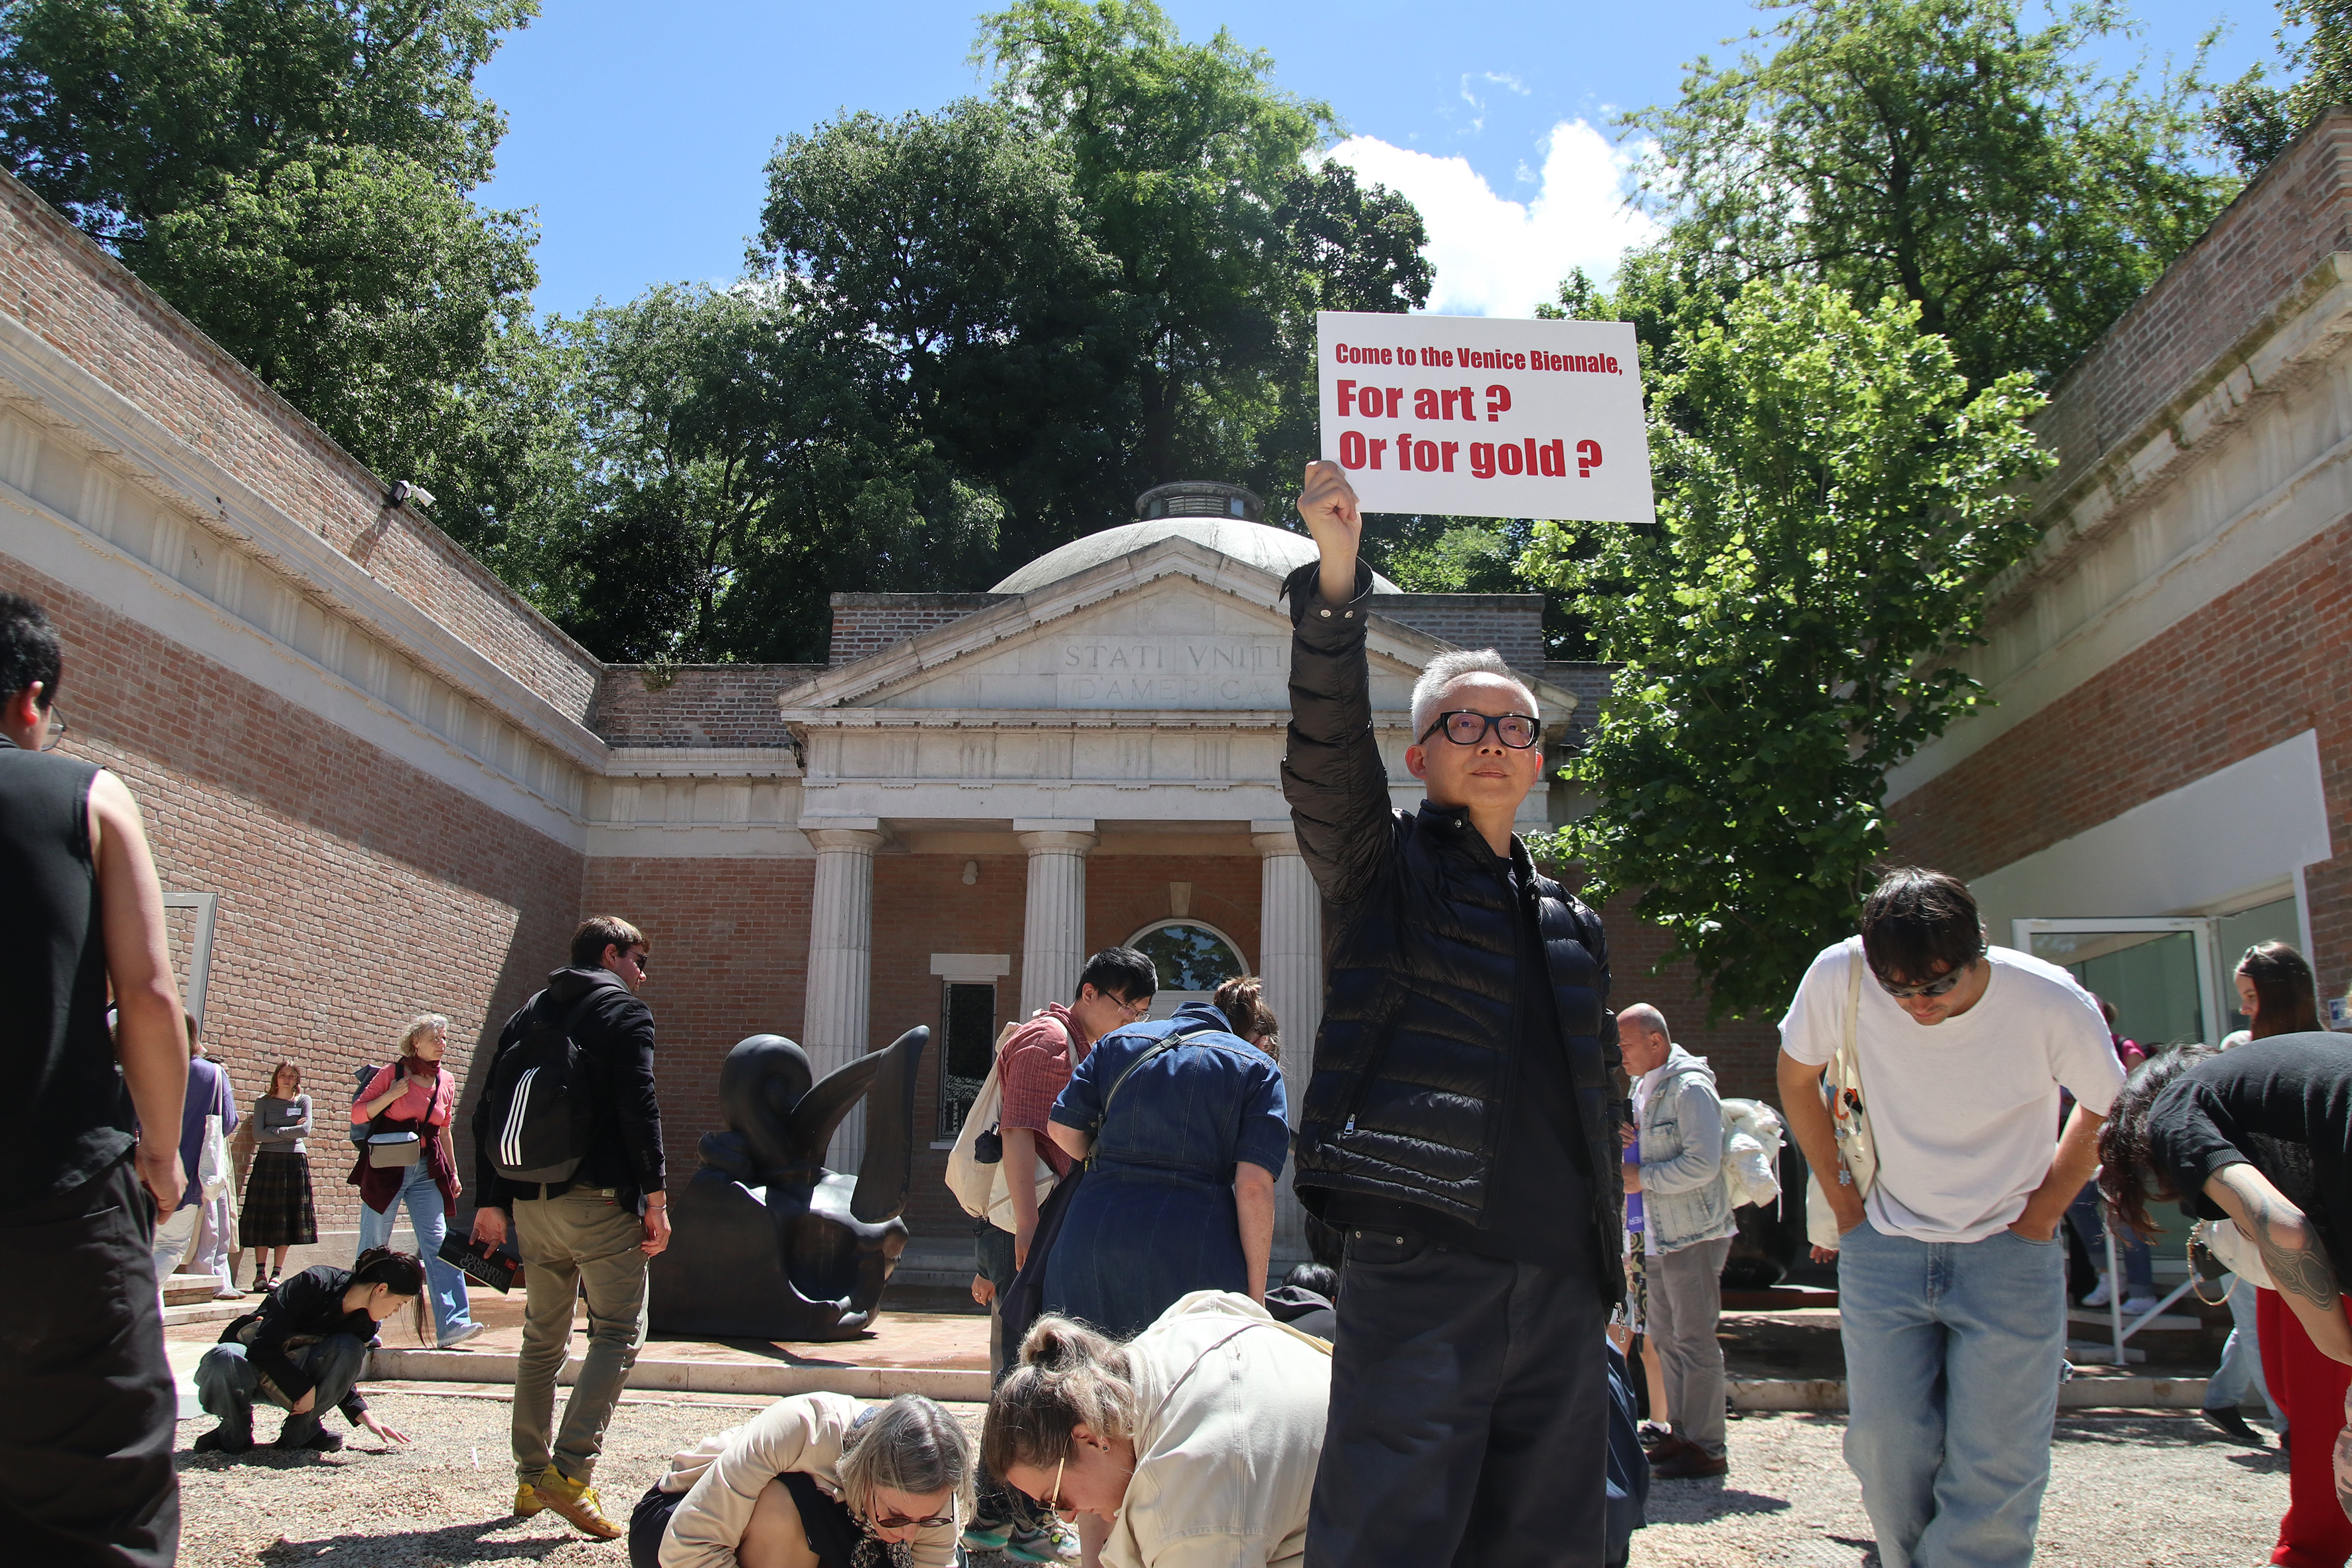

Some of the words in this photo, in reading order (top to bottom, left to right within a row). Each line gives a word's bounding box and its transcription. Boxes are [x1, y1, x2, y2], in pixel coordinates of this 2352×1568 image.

[1336, 343, 1392, 365] Come
[1396, 347, 1417, 366] to
[1421, 347, 1453, 368] the
[1457, 348, 1526, 370] Venice
[1530, 351, 1623, 376] Biennale,
[1337, 380, 1403, 418] For
[1414, 386, 1476, 422] art
[1486, 384, 1512, 422] ?
[1340, 431, 1387, 470] Or
[1396, 433, 1459, 473] for
[1470, 438, 1566, 479] gold
[1577, 439, 1603, 478] ?
[1065, 645, 1163, 667] STATI
[1187, 645, 1283, 667] VNITI
[459, 1258, 505, 1287] cosmi
[465, 1253, 507, 1278] pneum
